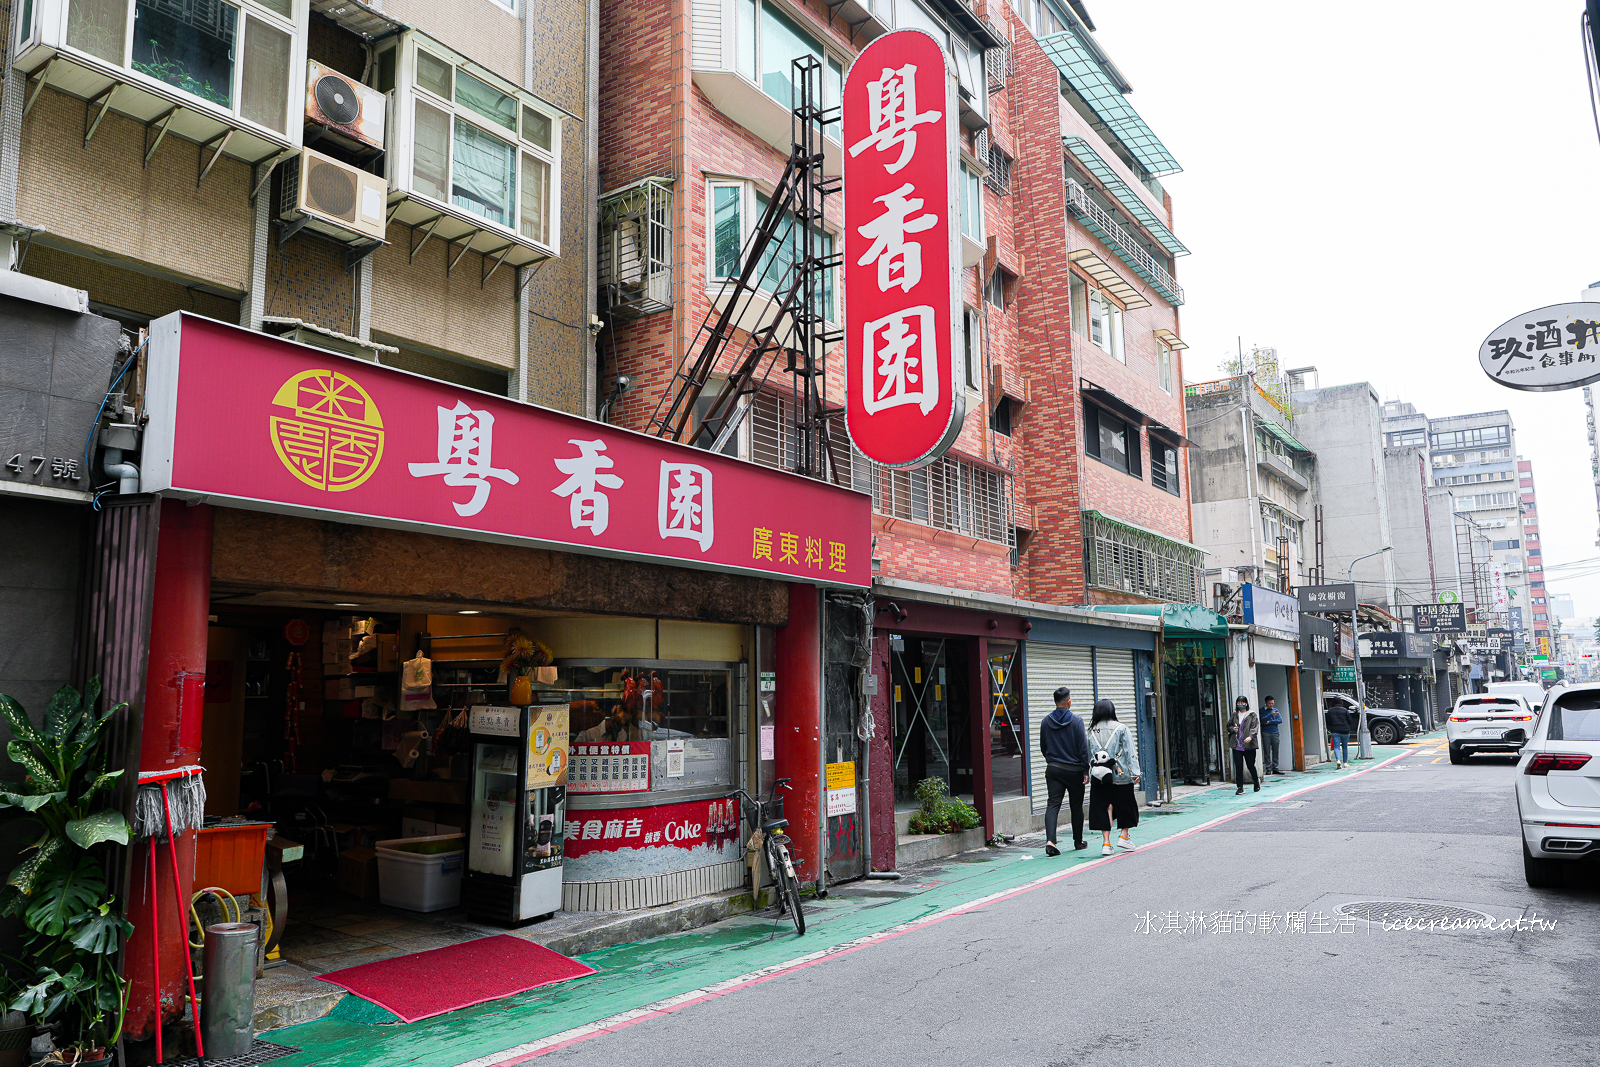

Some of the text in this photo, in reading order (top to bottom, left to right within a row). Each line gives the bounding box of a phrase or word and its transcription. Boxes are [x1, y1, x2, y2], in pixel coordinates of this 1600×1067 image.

[848, 63, 943, 417] 粵香園
[5, 452, 82, 481] 47號
[407, 399, 715, 553] 粵香園
[751, 526, 848, 574] 廣東料理
[563, 817, 644, 841] 美食麻吉
[664, 819, 702, 842] Coke
